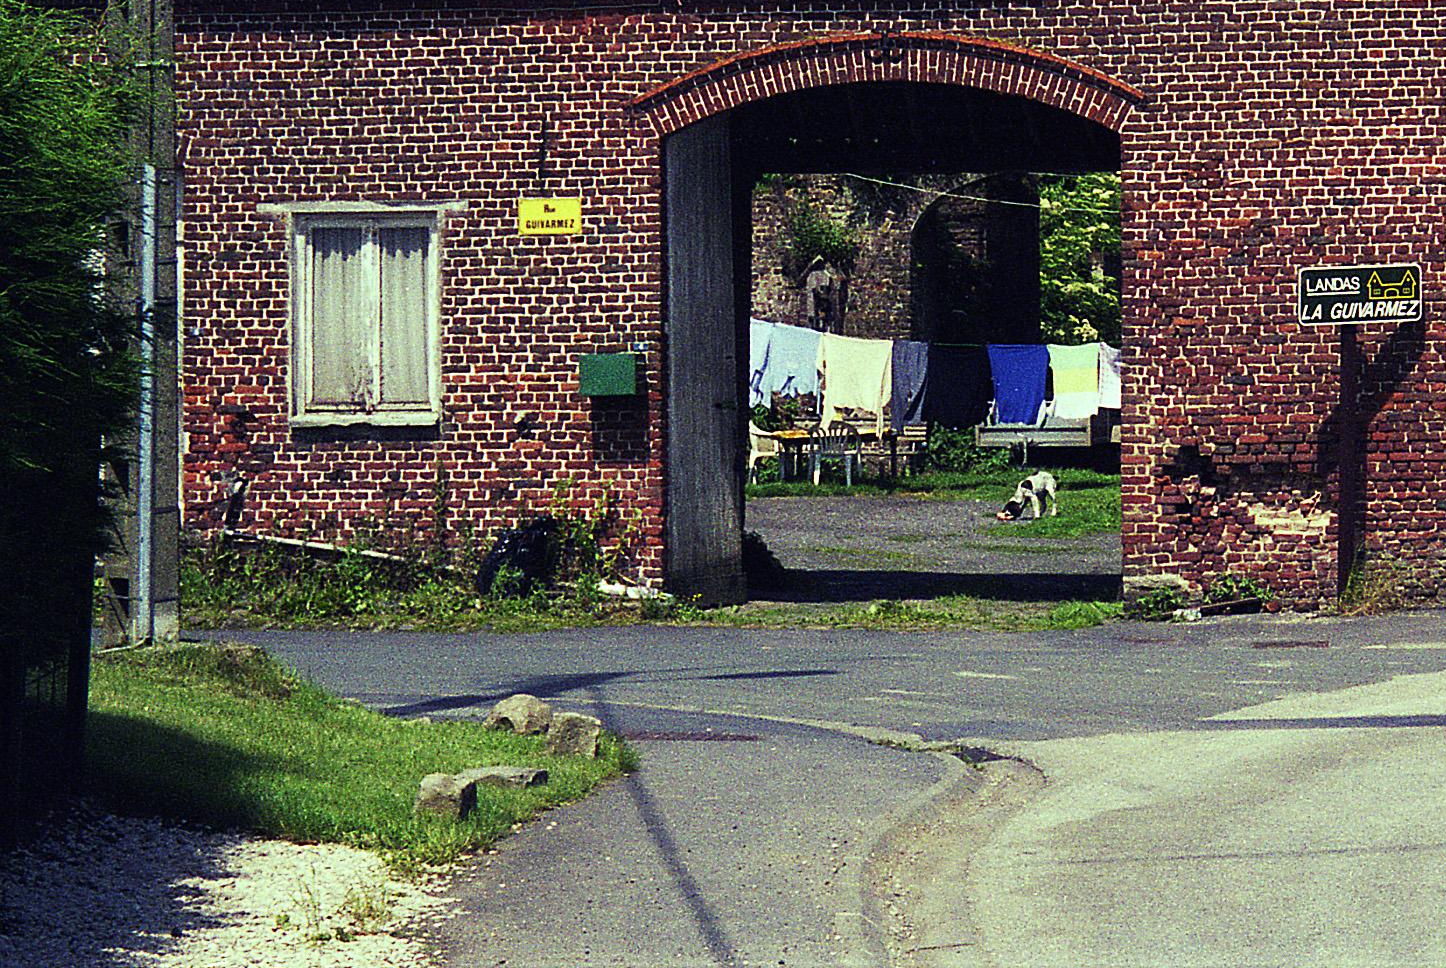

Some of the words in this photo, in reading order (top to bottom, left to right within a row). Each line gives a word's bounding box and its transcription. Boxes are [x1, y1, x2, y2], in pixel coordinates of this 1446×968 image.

[526, 219, 575, 229] GUIVARMEZ
[1306, 276, 1361, 293] LANDAS
[1301, 303, 1323, 321] LA
[1330, 300, 1421, 320] GUIVARMEZ
